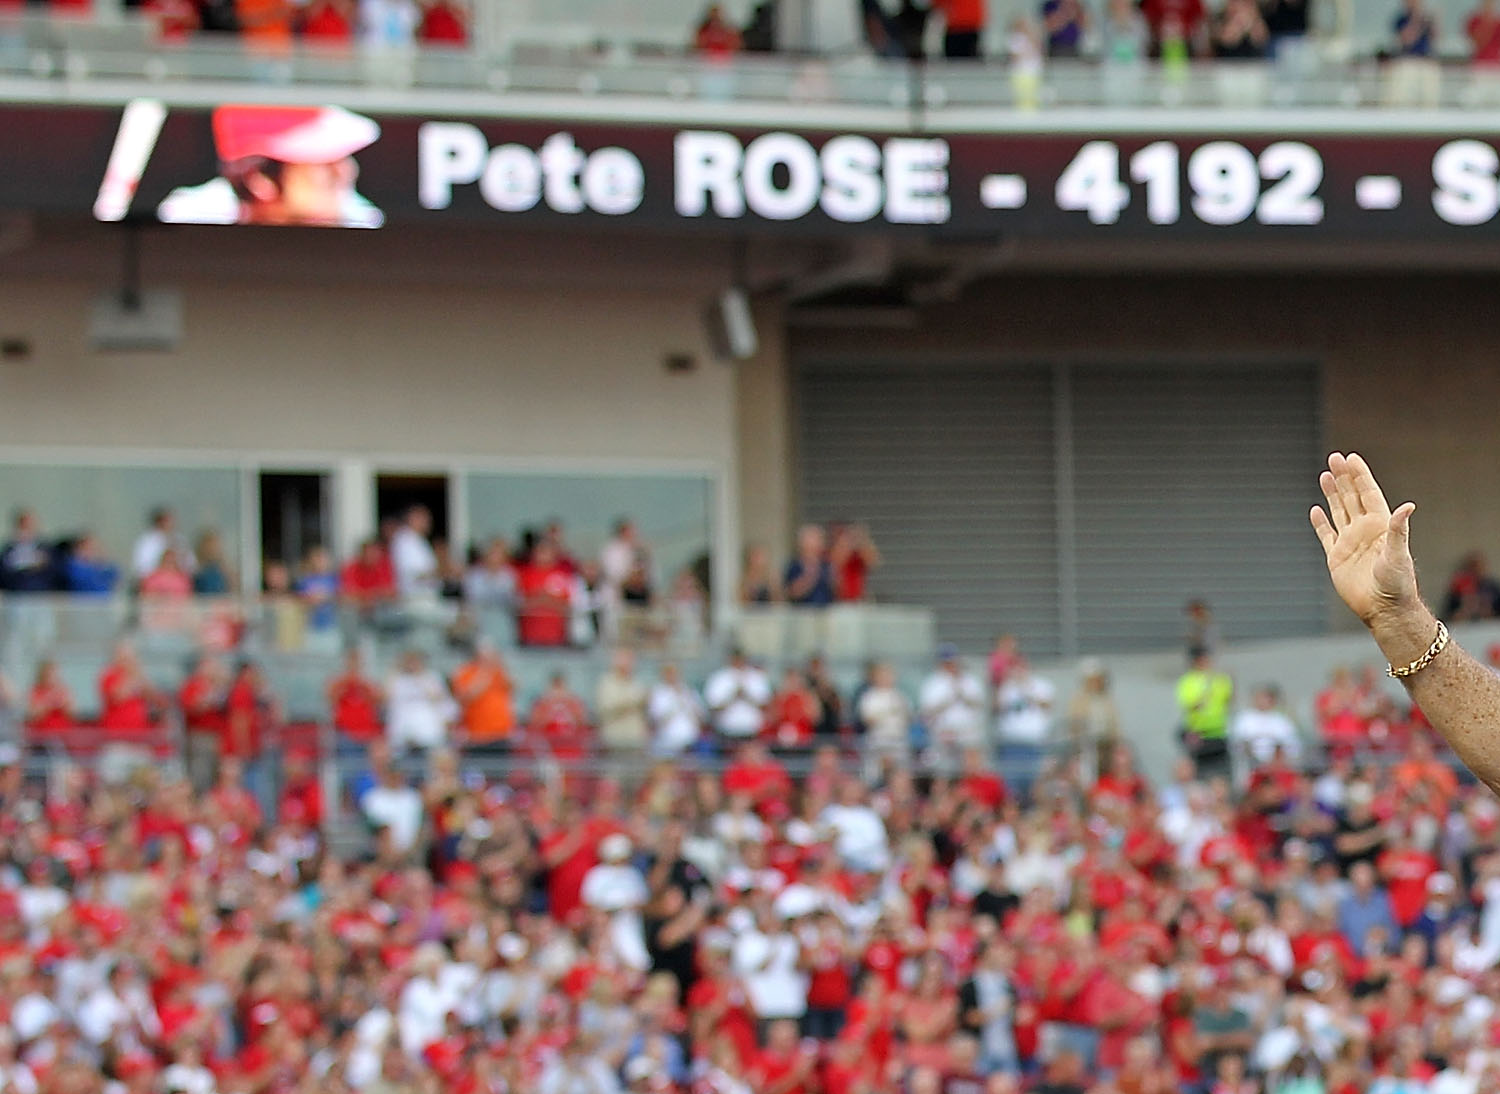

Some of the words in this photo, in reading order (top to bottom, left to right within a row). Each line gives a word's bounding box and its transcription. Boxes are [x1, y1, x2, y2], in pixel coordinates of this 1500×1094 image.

[418, 121, 646, 215] Pete
[673, 130, 951, 225] ROSE
[1054, 140, 1325, 225] 4192
